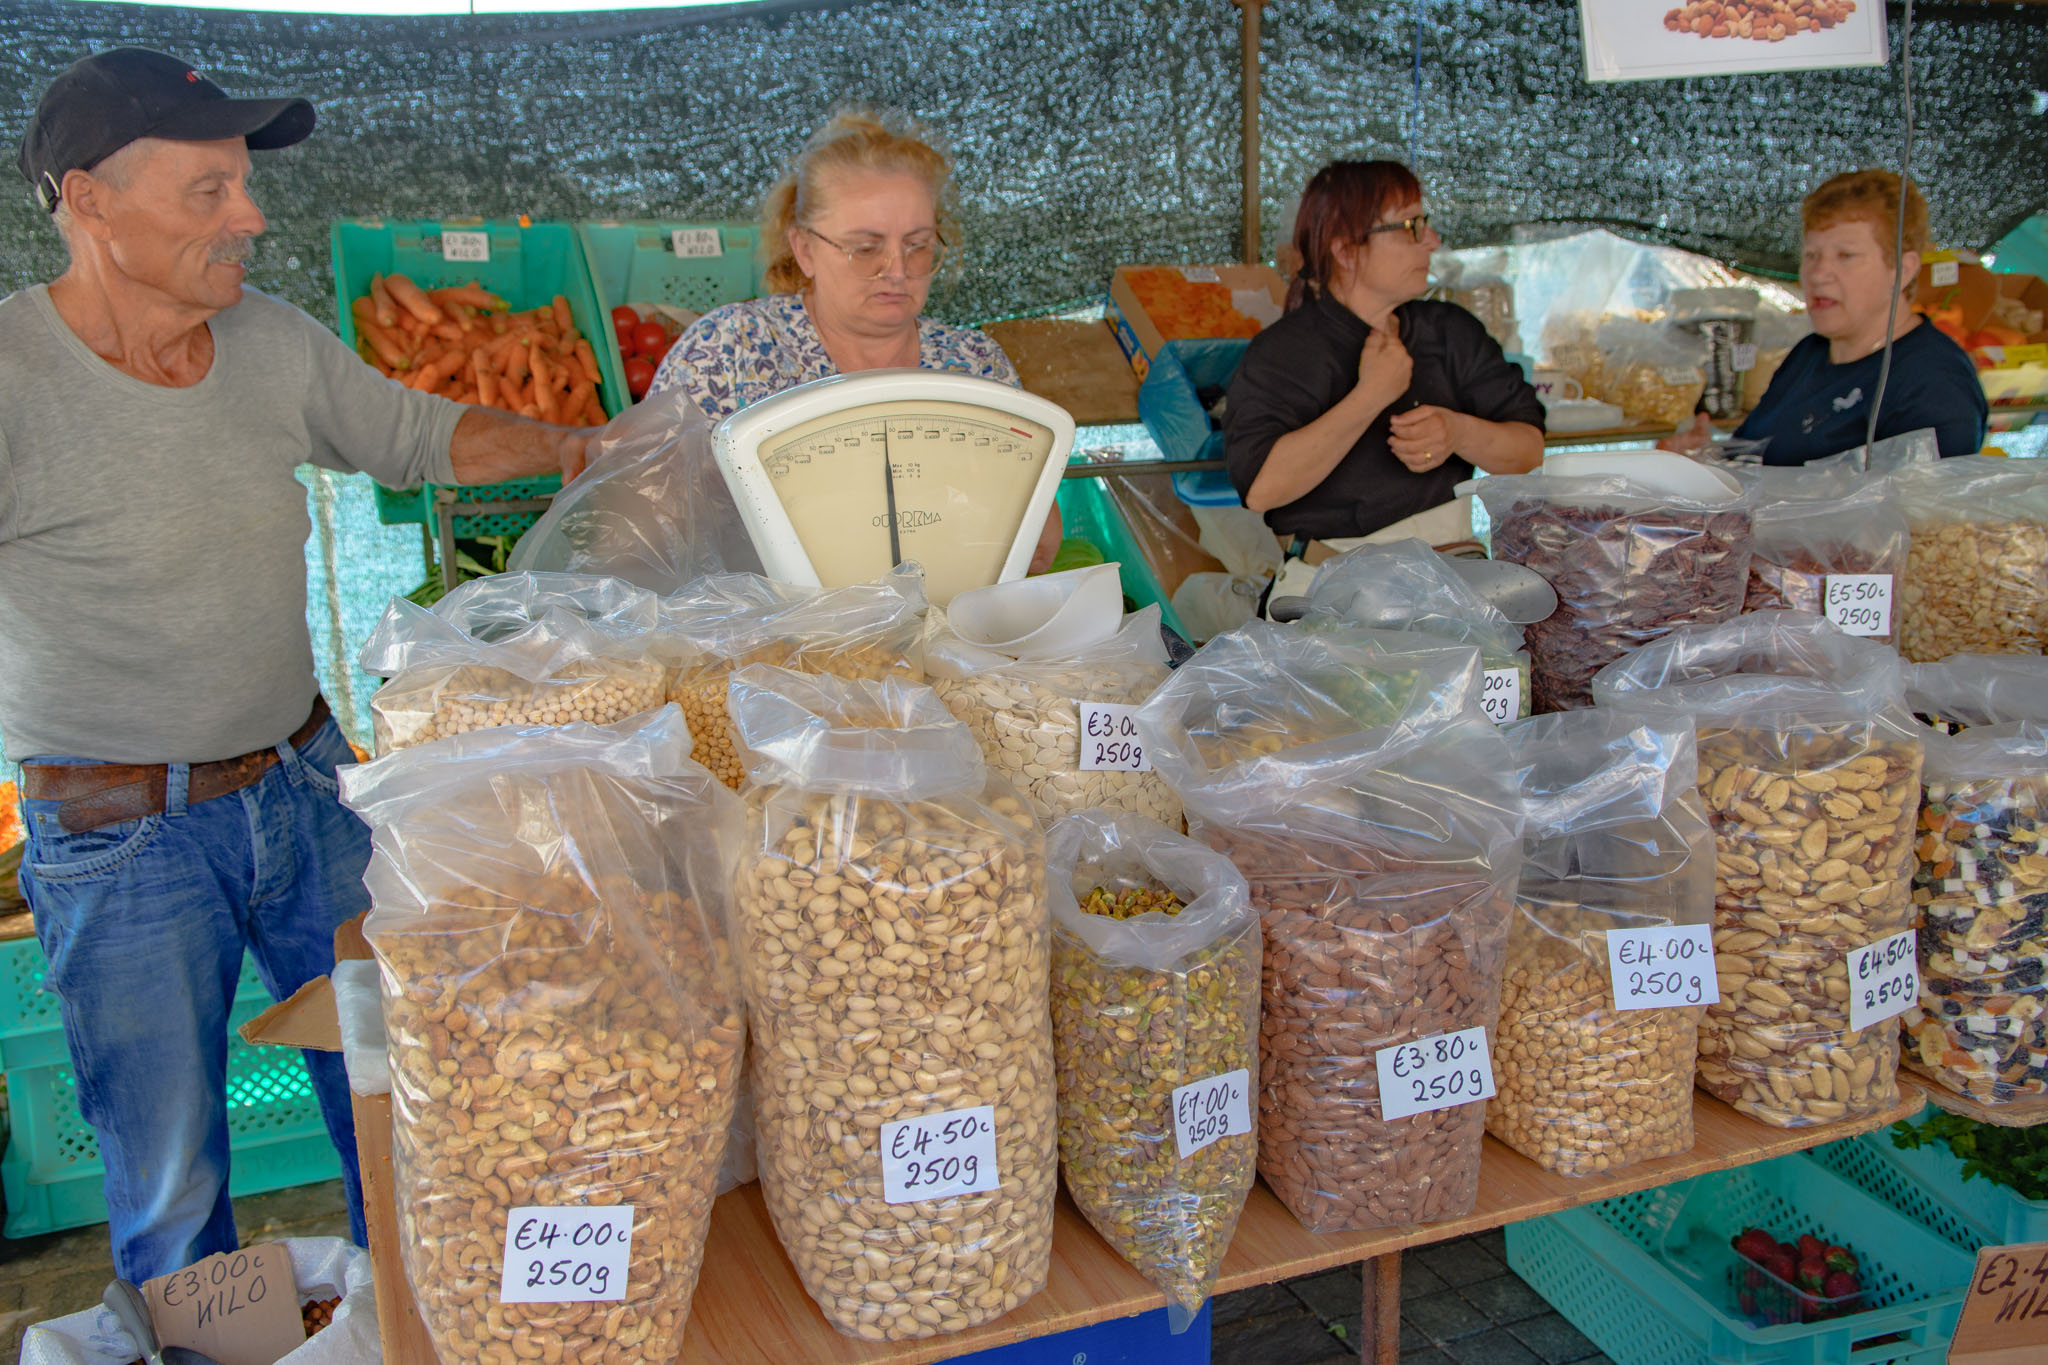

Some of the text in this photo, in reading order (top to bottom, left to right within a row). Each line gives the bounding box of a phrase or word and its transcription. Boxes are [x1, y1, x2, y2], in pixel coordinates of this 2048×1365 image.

[1829, 582, 1885, 605] €5.50c
[1839, 607, 1881, 631] 250g
[1095, 742, 1142, 768] 250g
[1619, 938, 1708, 966] €4.00c
[1859, 936, 1914, 980] €4.50c
[1864, 973, 1914, 1010] 250g
[1393, 1035, 1478, 1078] €3.80c
[1412, 1069, 1483, 1102] 250g
[891, 1116, 990, 1160] €4.50c
[1188, 1113, 1229, 1145] 250g
[904, 1155, 978, 1190] 250g
[514, 1218, 628, 1251] €4.00c
[163, 1253, 265, 1307] €3.00c
[526, 1259, 610, 1295] 250g
[198, 1275, 267, 1329] KILO
